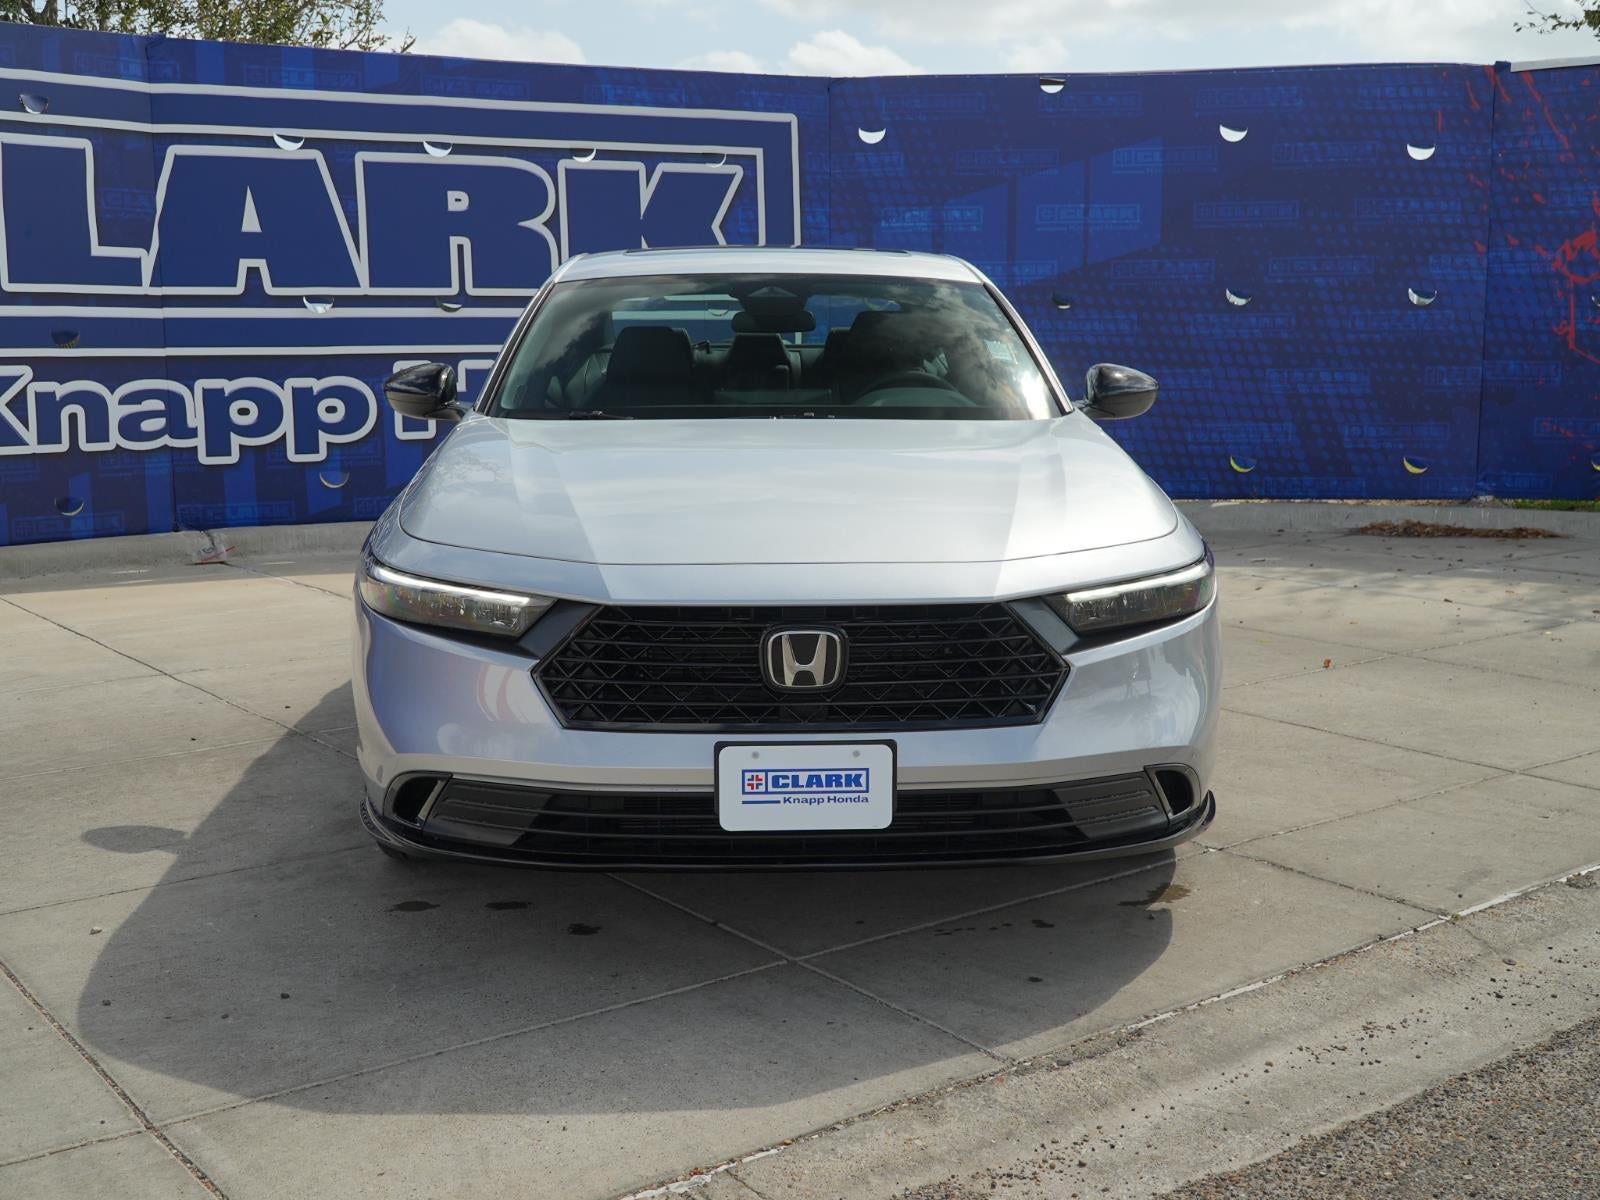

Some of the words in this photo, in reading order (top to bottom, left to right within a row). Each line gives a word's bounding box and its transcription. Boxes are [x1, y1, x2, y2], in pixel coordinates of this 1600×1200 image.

[771, 773, 864, 789] CLARK
[783, 795, 825, 806] Knapp
[827, 795, 869, 804] Honda
